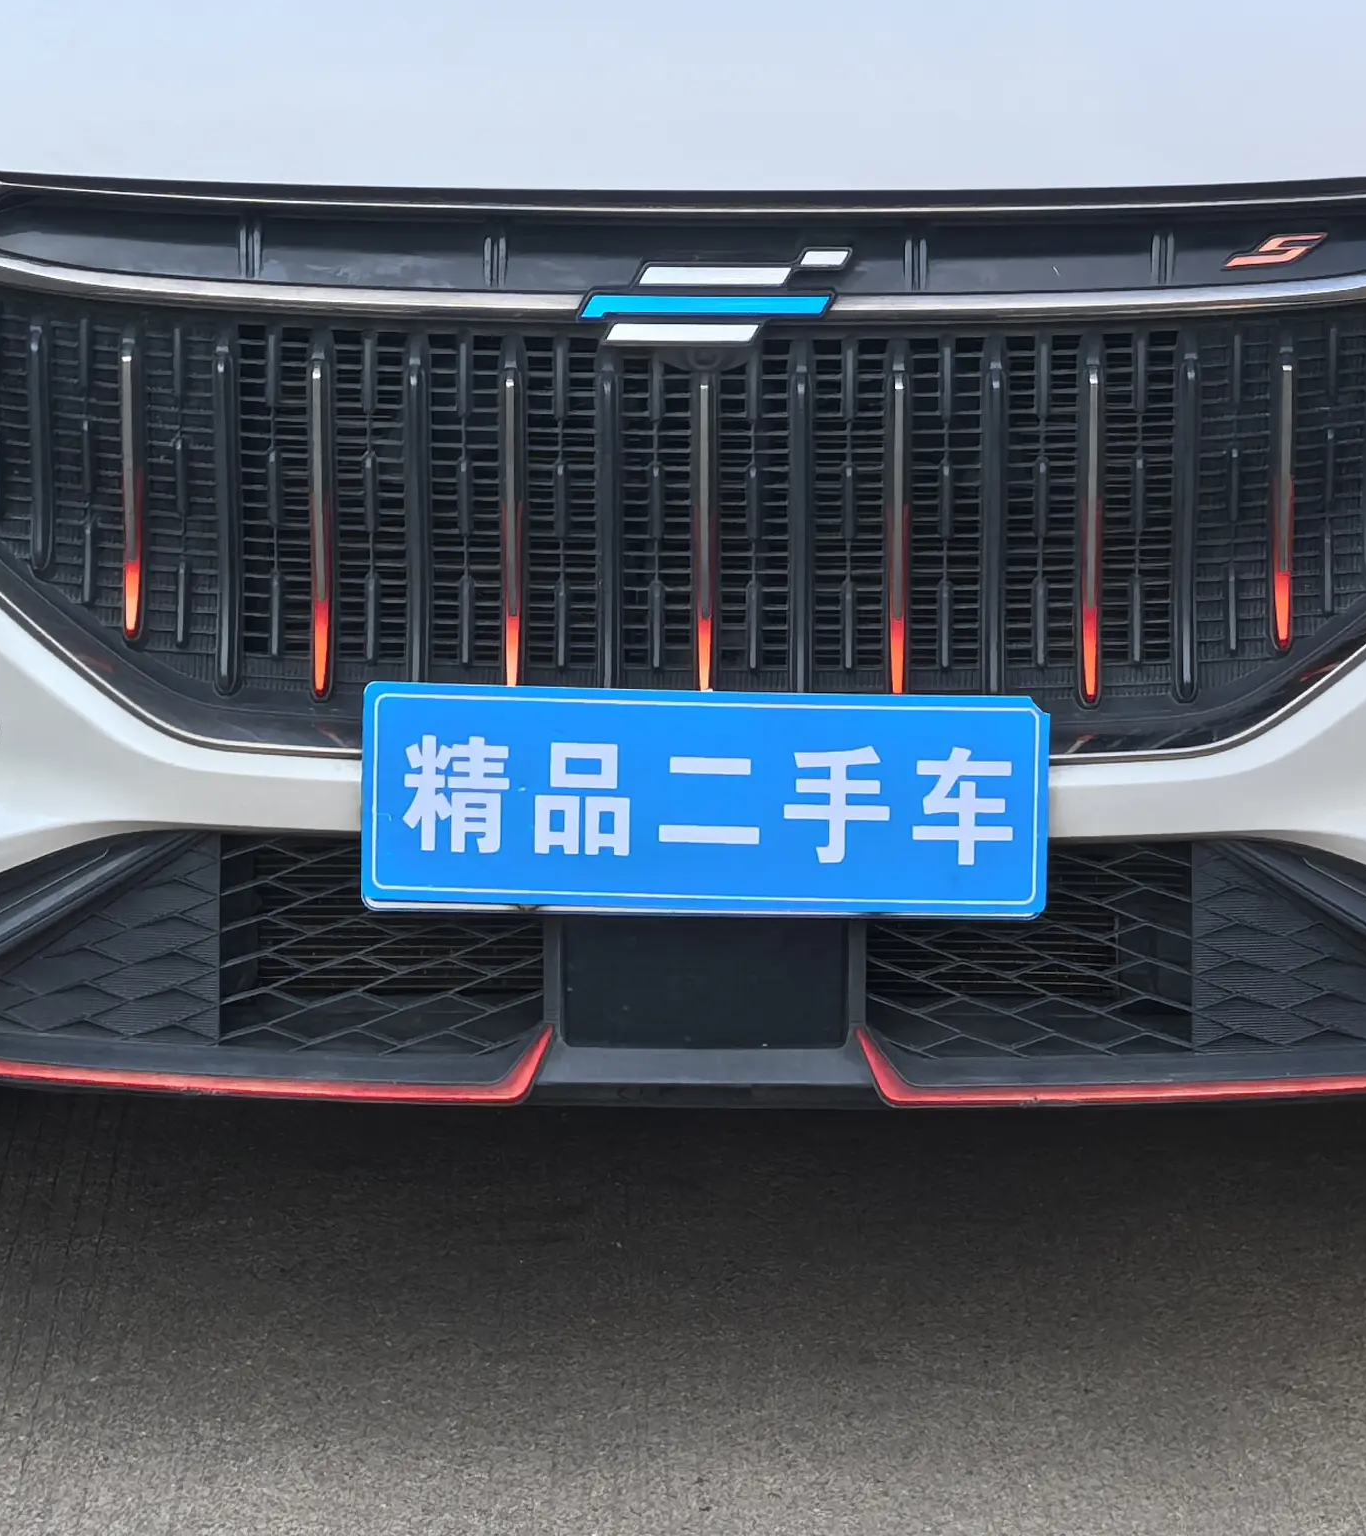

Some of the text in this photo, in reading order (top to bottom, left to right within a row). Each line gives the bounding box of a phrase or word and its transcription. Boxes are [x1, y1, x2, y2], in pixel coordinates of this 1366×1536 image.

[403, 735, 1014, 866] 精品二手车
